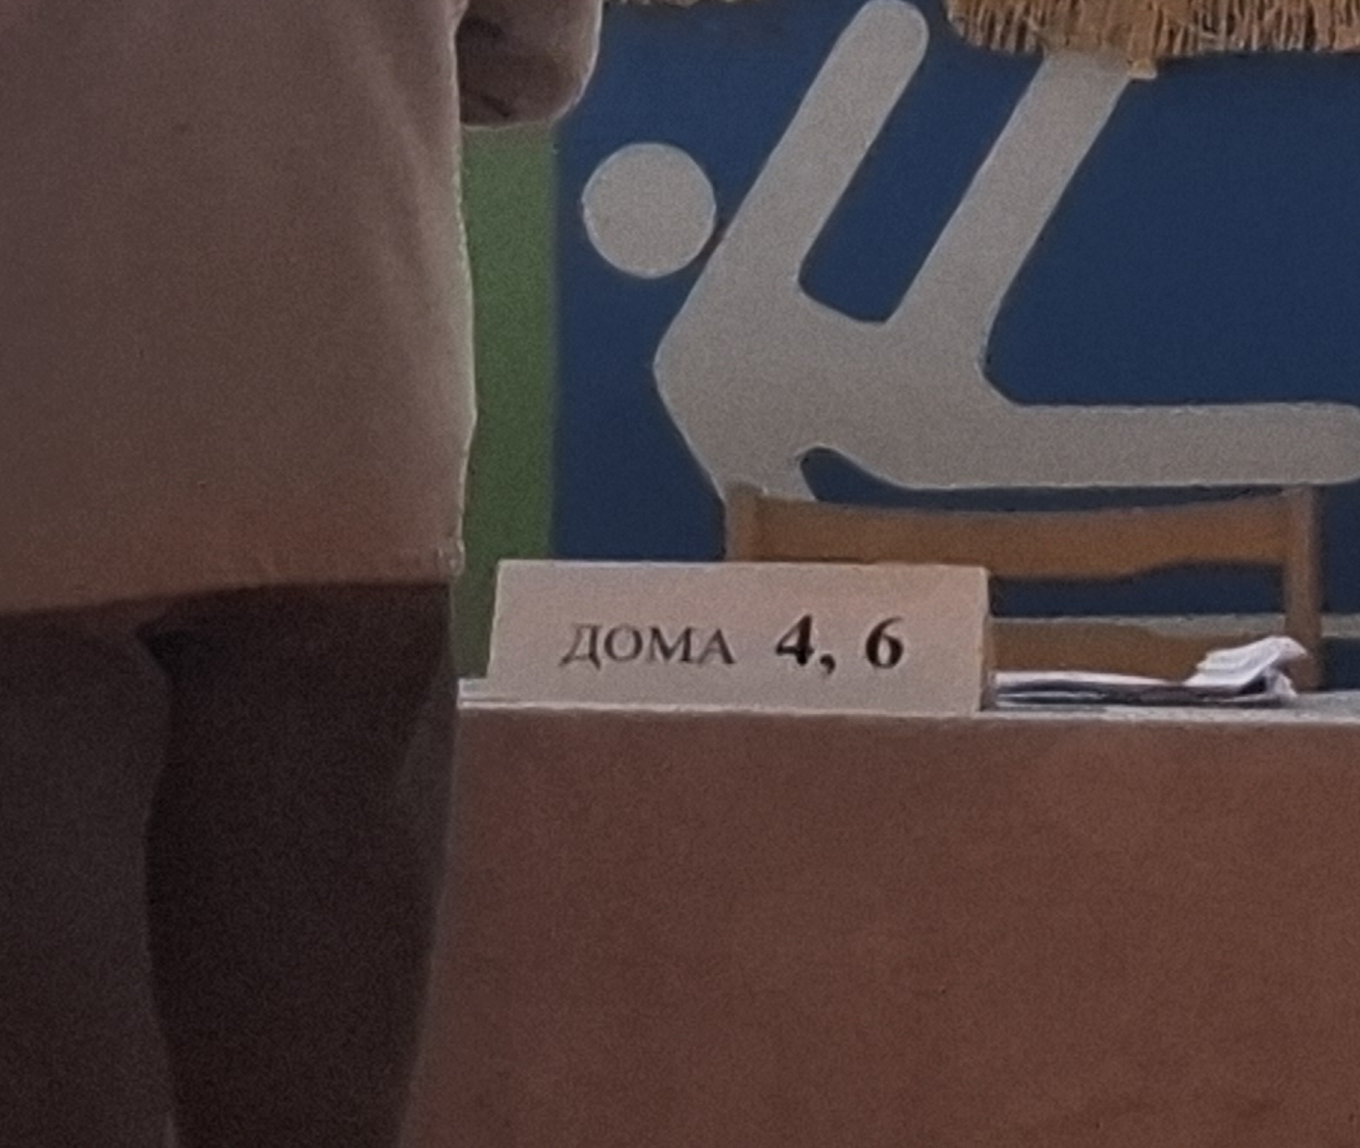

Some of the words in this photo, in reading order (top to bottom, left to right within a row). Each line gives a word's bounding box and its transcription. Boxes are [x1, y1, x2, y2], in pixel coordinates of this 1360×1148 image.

[559, 622, 735, 671] ДОМА
[775, 613, 836, 675] 4,
[865, 615, 905, 670] 6
